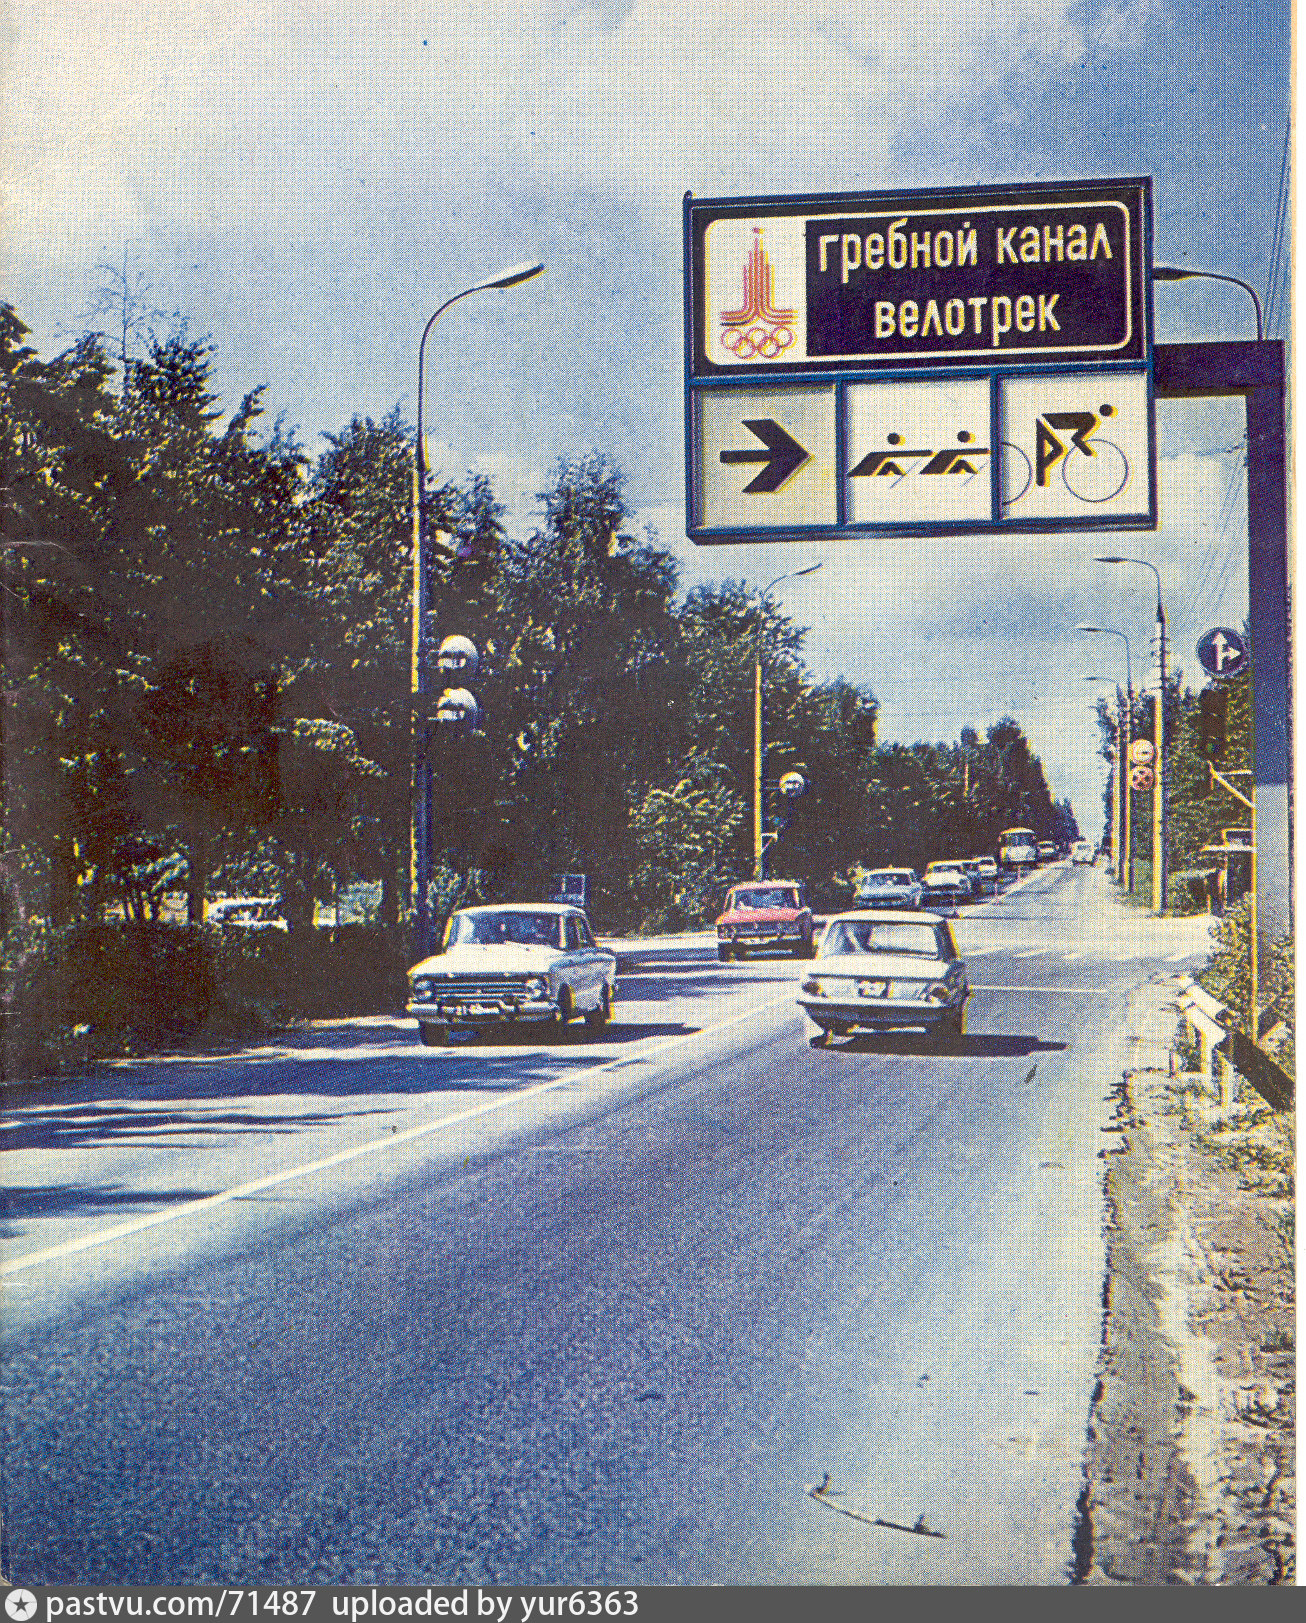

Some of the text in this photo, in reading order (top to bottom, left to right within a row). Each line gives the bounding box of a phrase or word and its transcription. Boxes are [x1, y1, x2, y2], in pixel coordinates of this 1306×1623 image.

[819, 217, 1114, 284] гребной канал
[874, 293, 1062, 347] велотрек
